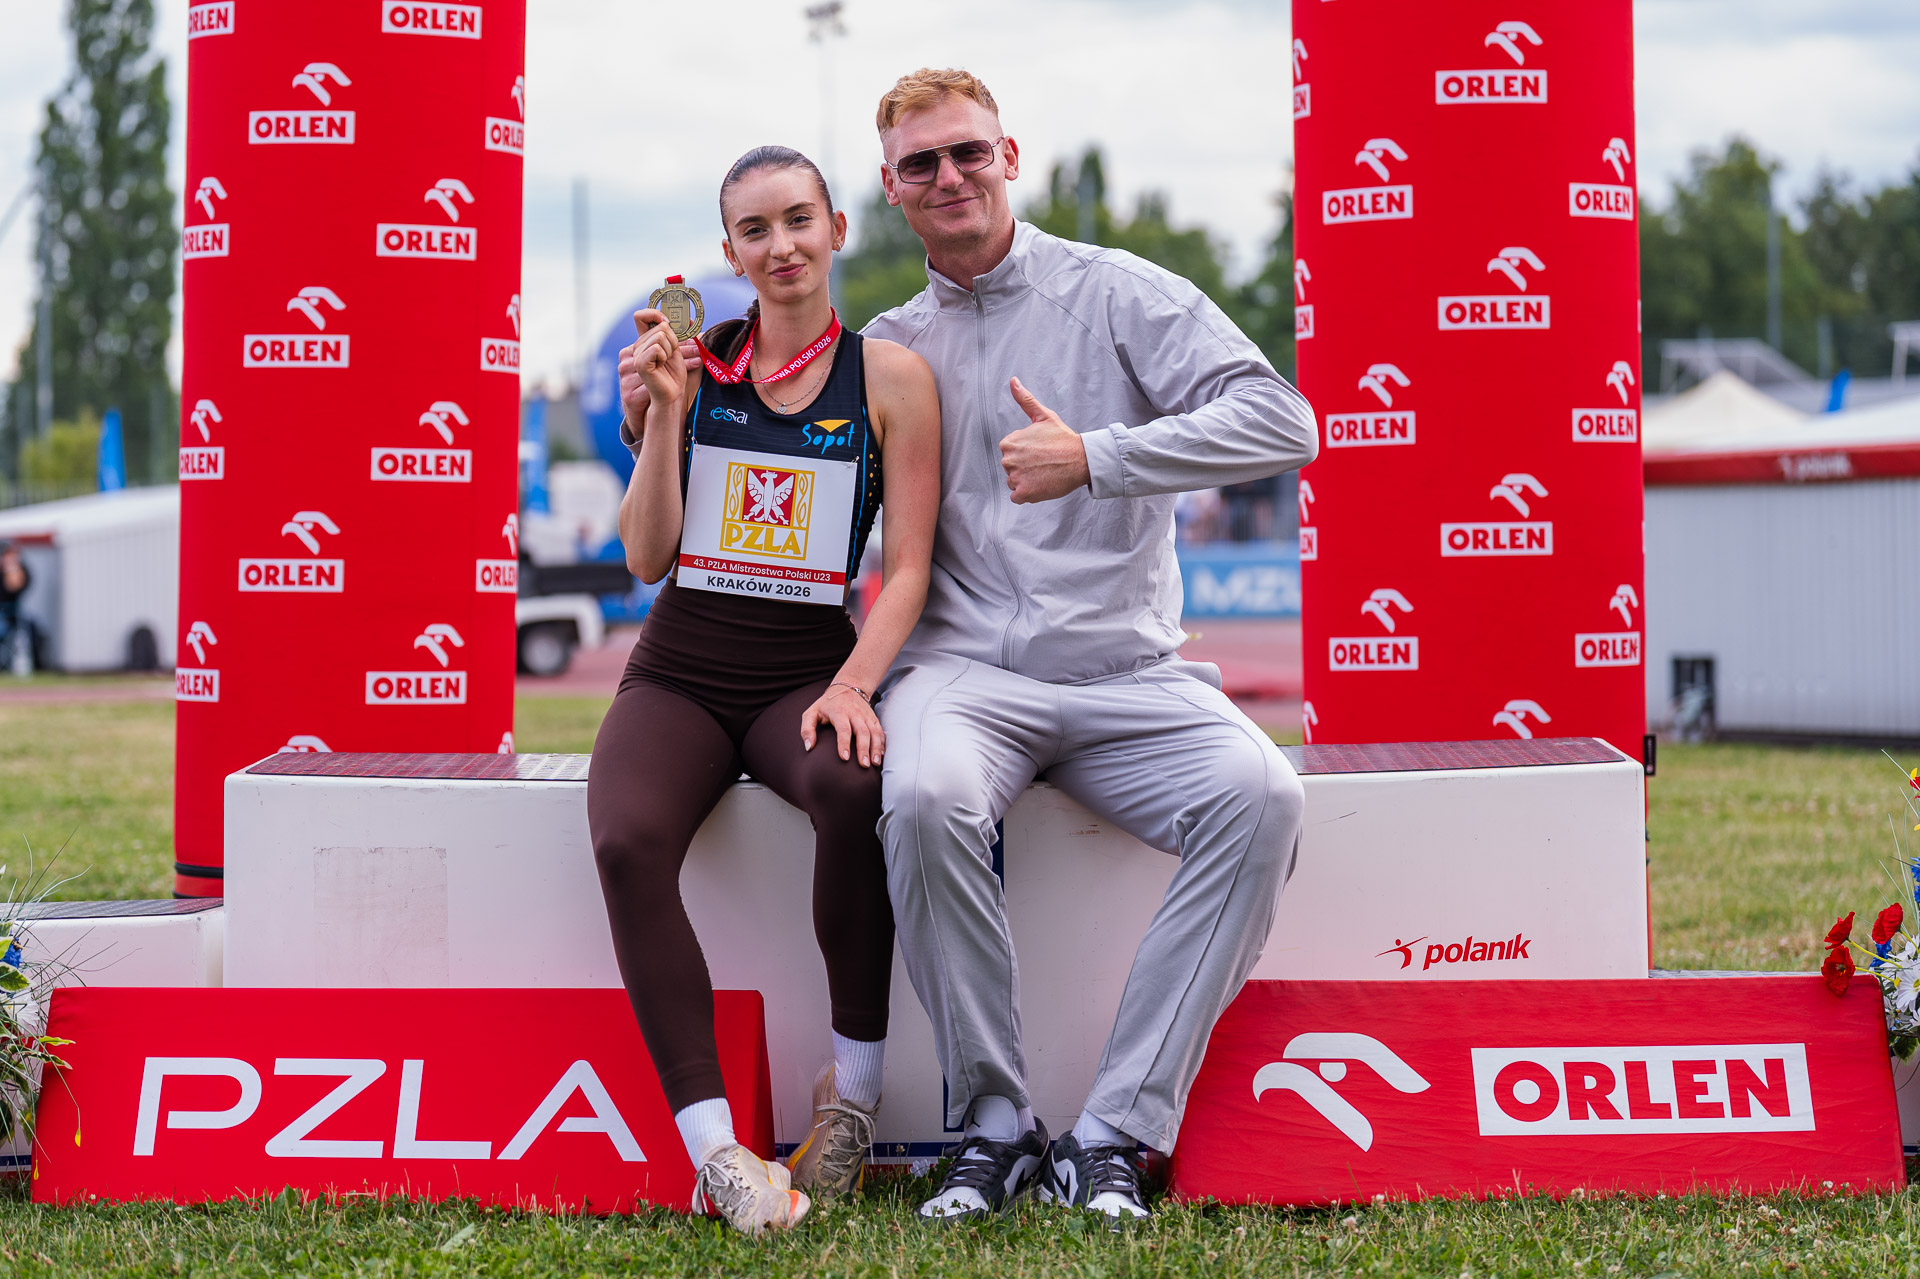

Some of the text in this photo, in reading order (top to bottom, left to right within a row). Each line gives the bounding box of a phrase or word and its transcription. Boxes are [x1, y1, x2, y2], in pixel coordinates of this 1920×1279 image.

[388, 6, 475, 33] ORLEN
[1442, 75, 1540, 98] ORLEN
[254, 116, 347, 138] ORLEN
[491, 124, 524, 148] ORLE
[1327, 191, 1406, 218] ORLEN
[1575, 189, 1631, 214] ORLEN
[383, 229, 470, 254] ORLEN
[1445, 301, 1542, 324] ORLEN
[250, 340, 341, 362] ORLEN
[486, 344, 520, 367] ORLE
[789, 348, 816, 371] POLSKI
[814, 334, 831, 353] 2026
[1331, 417, 1408, 441] ORLEN
[1577, 414, 1634, 436] ORLEN
[801, 423, 855, 455] Sopot
[378, 454, 465, 476] ORLEN
[725, 523, 801, 555] PZLA
[1447, 527, 1546, 550] ORLEN
[244, 564, 336, 586] ORLEN
[481, 565, 516, 587] ORLE
[693, 558, 831, 582] 43. PZLA Mistrzostwa Polski U23
[707, 575, 811, 597] KRAKÓW 2026
[1333, 642, 1411, 665] ORLEN
[1580, 639, 1638, 661] ORLEN
[372, 677, 460, 699] ORLEN
[1423, 933, 1532, 971] polanik
[1493, 1058, 1791, 1123] ORLEN
[133, 1057, 647, 1162] PZLA
